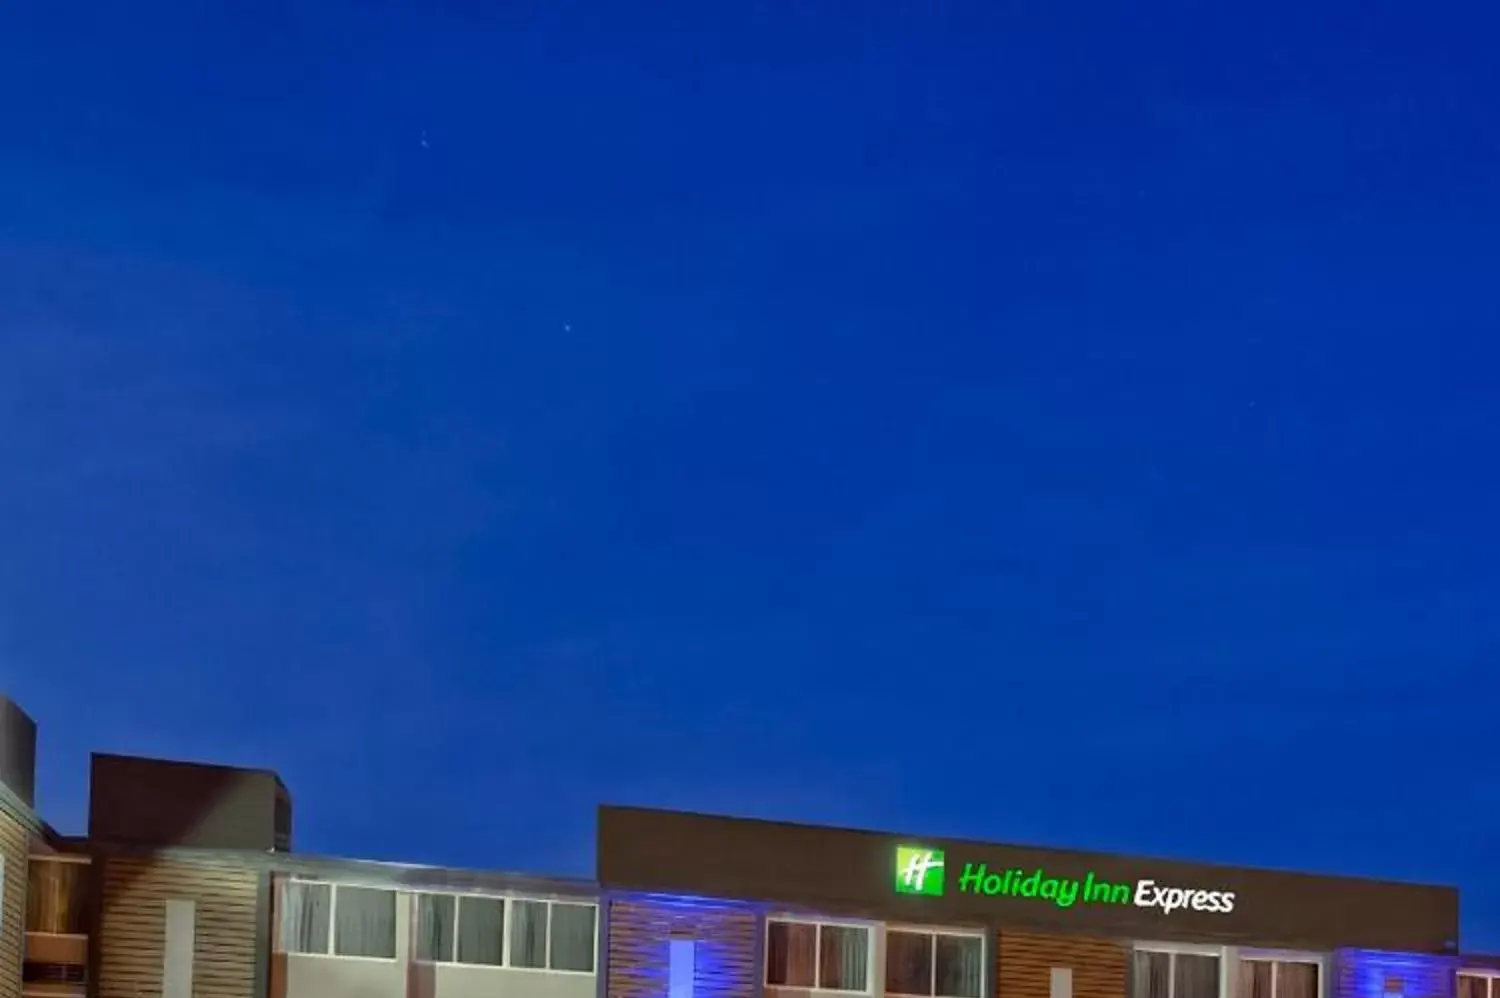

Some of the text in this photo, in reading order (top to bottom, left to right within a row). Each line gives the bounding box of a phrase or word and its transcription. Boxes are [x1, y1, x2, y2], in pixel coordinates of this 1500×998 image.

[959, 863, 1235, 914] Holiday Inn Express
